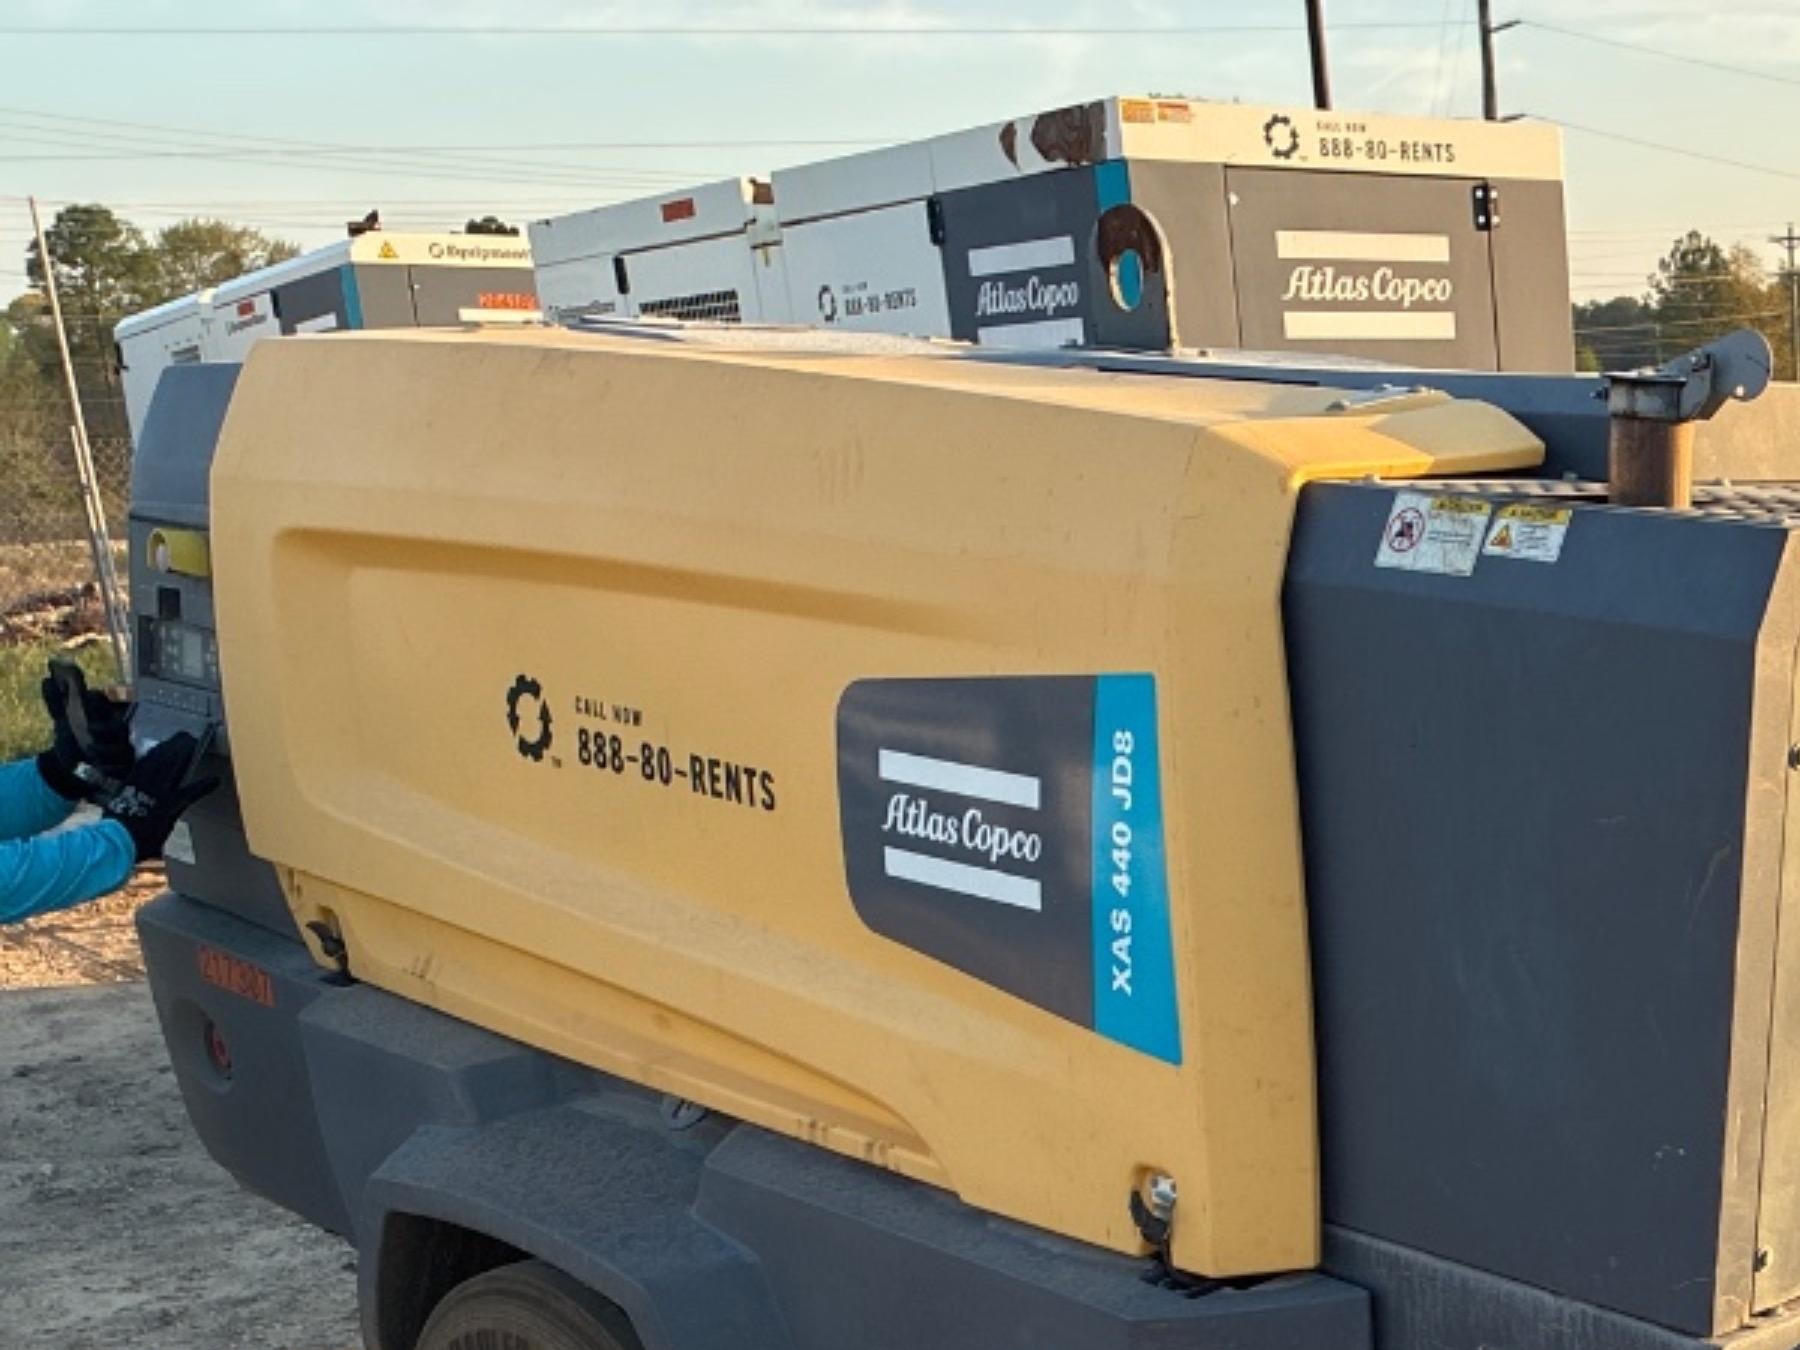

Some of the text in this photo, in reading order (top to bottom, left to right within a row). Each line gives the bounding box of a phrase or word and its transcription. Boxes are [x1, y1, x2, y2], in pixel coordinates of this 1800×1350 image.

[1319, 137, 1456, 163] 888-80-RENTS
[976, 276, 1080, 316] Atlas Copco
[1282, 265, 1453, 308] Atlas Copco
[575, 695, 643, 727] CALL NOW
[577, 727, 776, 811] 888-80-RENTS
[881, 793, 1042, 863] Atlas Copco
[1111, 729, 1136, 997] XAS 440 JD8
